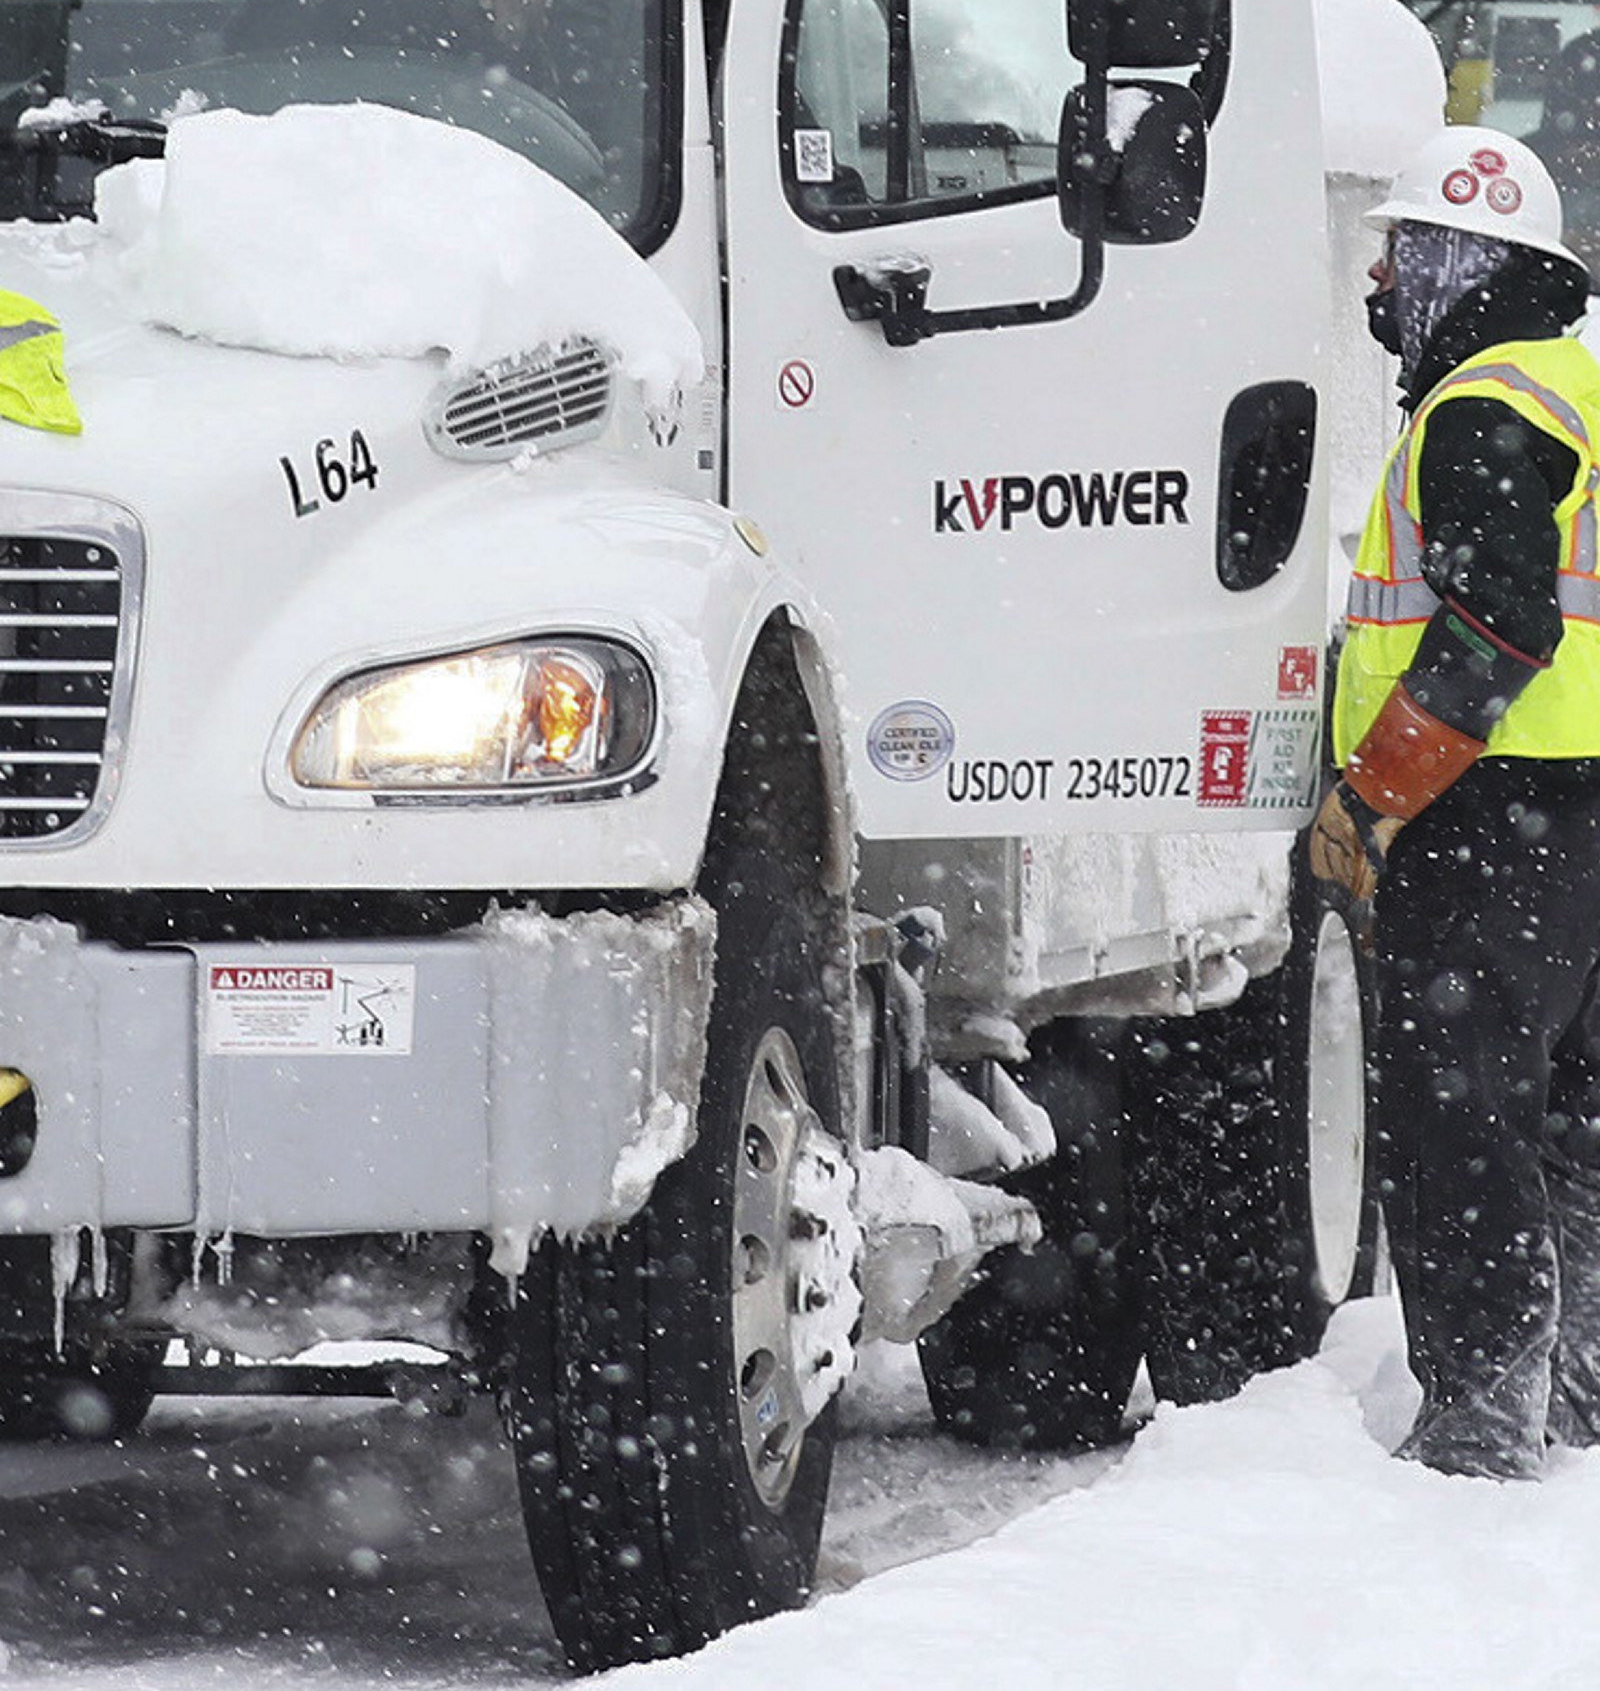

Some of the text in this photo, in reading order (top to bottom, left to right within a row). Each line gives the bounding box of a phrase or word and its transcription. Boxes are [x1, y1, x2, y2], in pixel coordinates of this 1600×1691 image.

[279, 428, 379, 518] L64
[947, 757, 1191, 802] USDOT 2345072
[236, 971, 328, 988] DANGER
